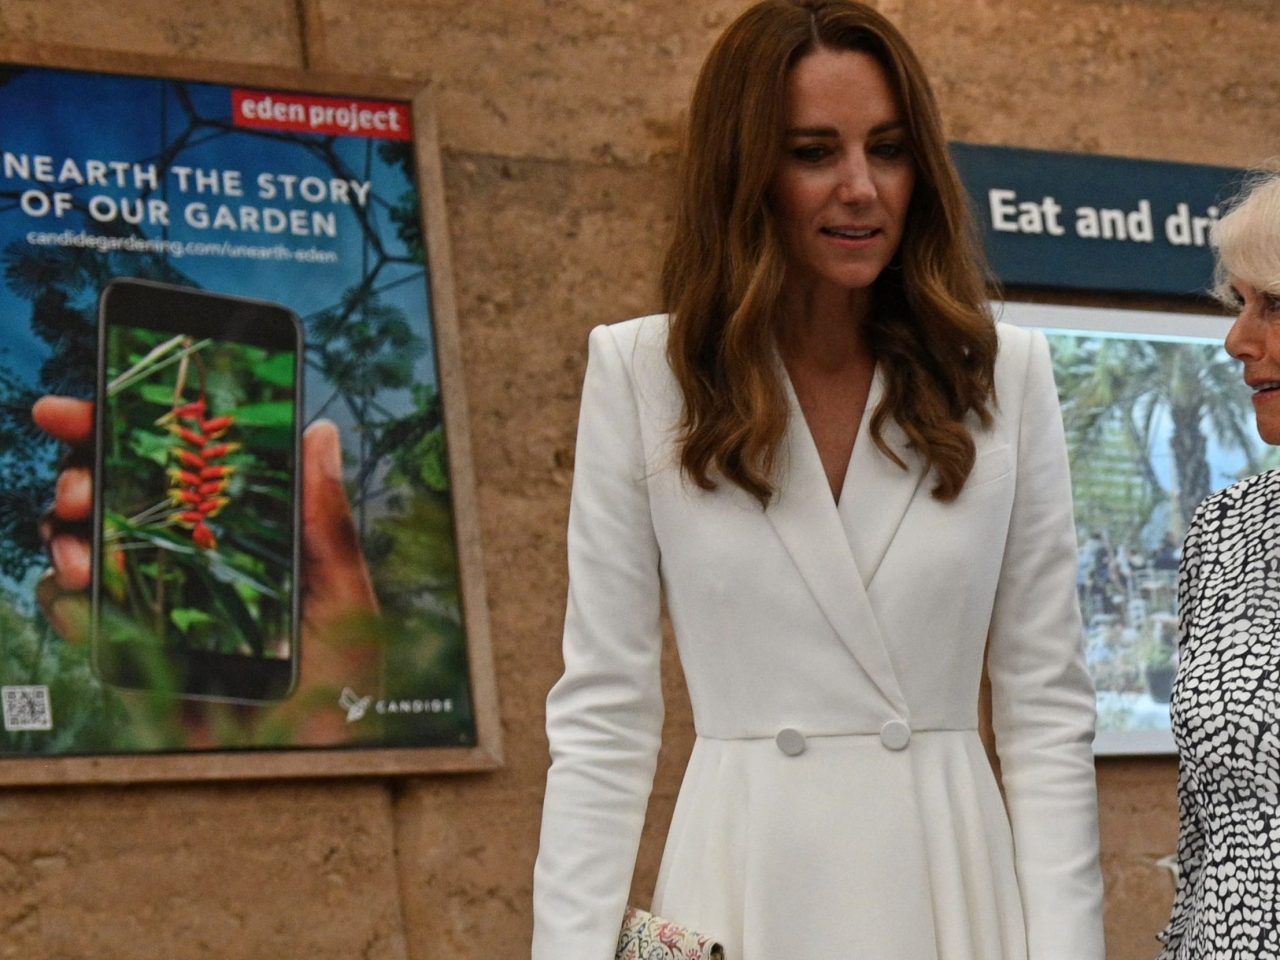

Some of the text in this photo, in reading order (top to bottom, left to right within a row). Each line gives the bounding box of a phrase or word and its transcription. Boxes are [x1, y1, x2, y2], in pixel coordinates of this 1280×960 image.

[241, 96, 400, 132] eden project
[172, 166, 243, 197] THE
[257, 172, 371, 207] STORY
[20, 189, 338, 238] OF OUR GARDEN
[988, 189, 1066, 236] Eat
[1075, 199, 1154, 242] and
[375, 699, 454, 715] CANDIDE
